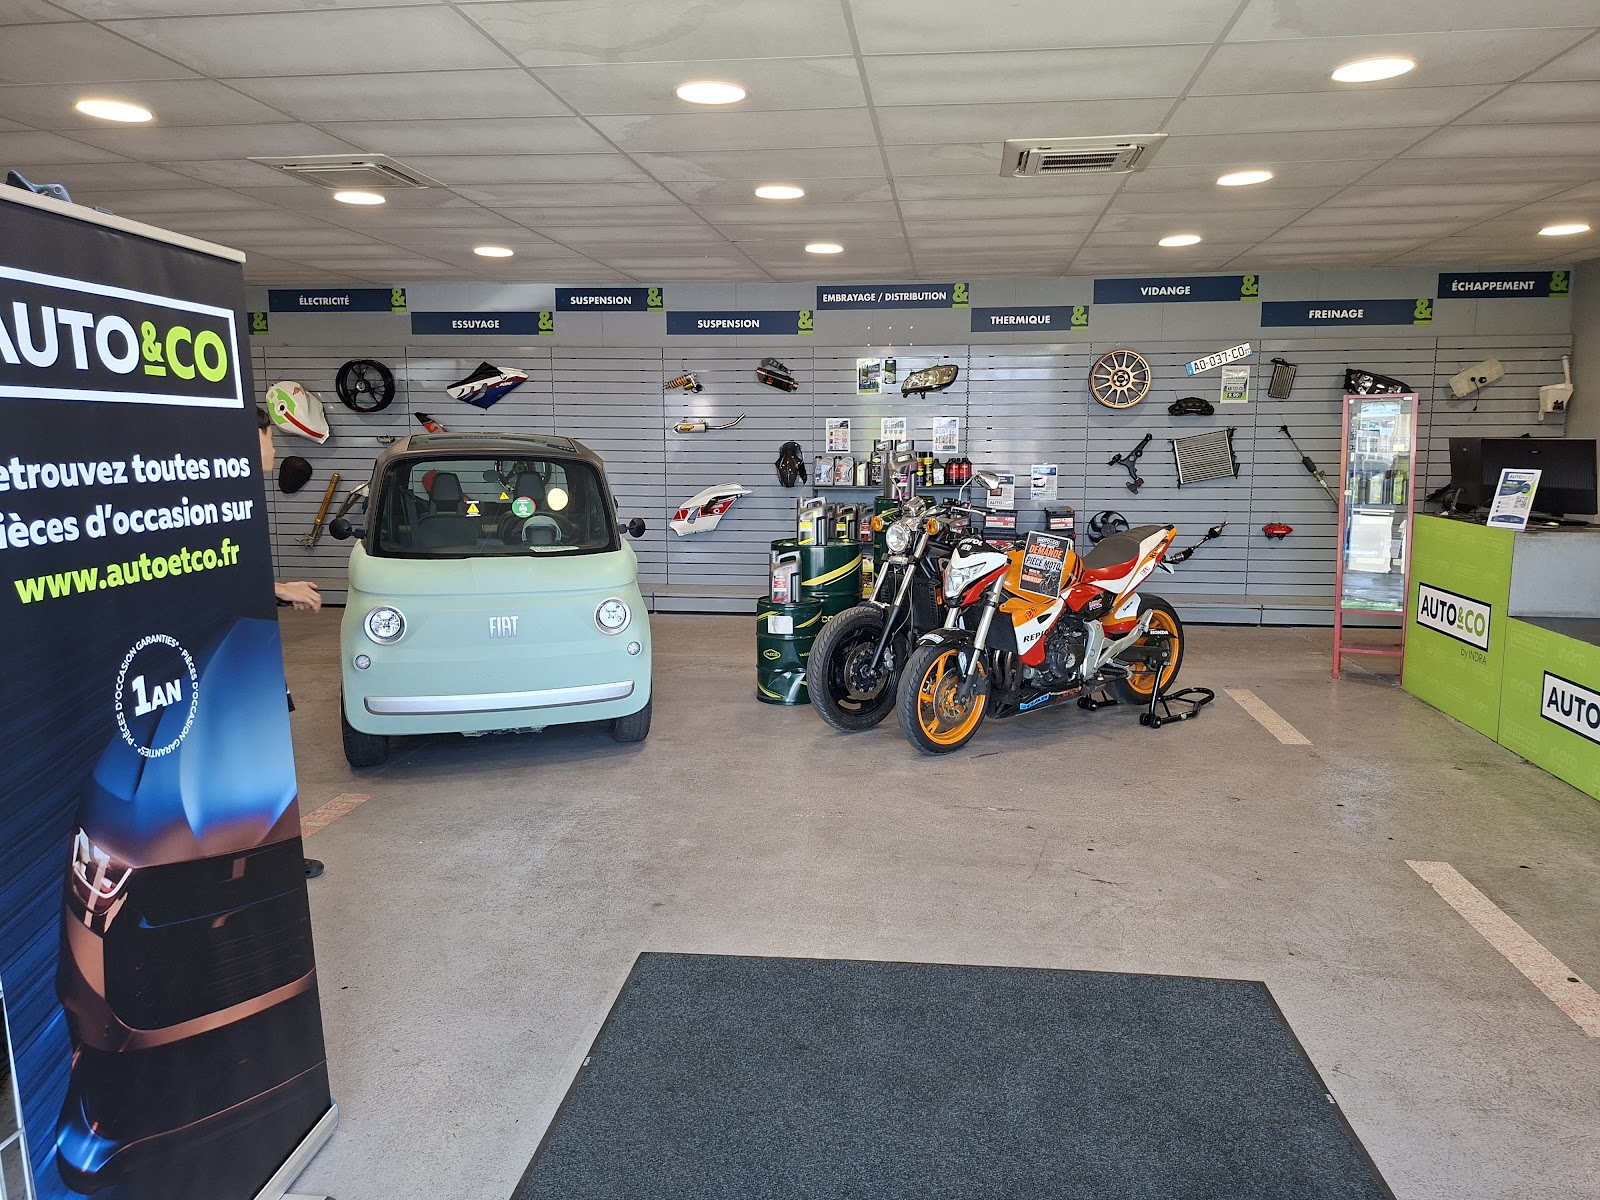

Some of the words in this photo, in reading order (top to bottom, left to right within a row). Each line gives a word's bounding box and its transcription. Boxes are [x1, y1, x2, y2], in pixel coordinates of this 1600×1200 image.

[1140, 285, 1191, 297] VIDANGE
[1451, 279, 1535, 293] ÉCHAPPEMENT
[299, 293, 350, 307] ÉLECTRICITÉ
[570, 295, 632, 306] SUSPENSION
[822, 292, 876, 303] EMBRAYAGE
[877, 292, 884, 303] /
[885, 290, 947, 302] DISTRIBUTION
[990, 314, 1051, 326] THERMIQUE
[1308, 308, 1364, 320] FREINAGE
[451, 319, 500, 330] ESSUYAGE
[697, 318, 760, 329] SUSPENSION
[131, 453, 211, 484] toutes
[213, 455, 251, 479] nos
[86, 496, 217, 539] d'occasion
[221, 498, 254, 522] sur
[1028, 544, 1064, 560] DEMANDE
[14, 537, 241, 604] www.autoetco.fr
[1044, 559, 1062, 571] MOTO
[1420, 594, 1486, 638] AUTO&CO
[488, 616, 519, 639] FIAT
[1468, 651, 1488, 667] INDRA
[1546, 686, 1600, 730] AUTO
